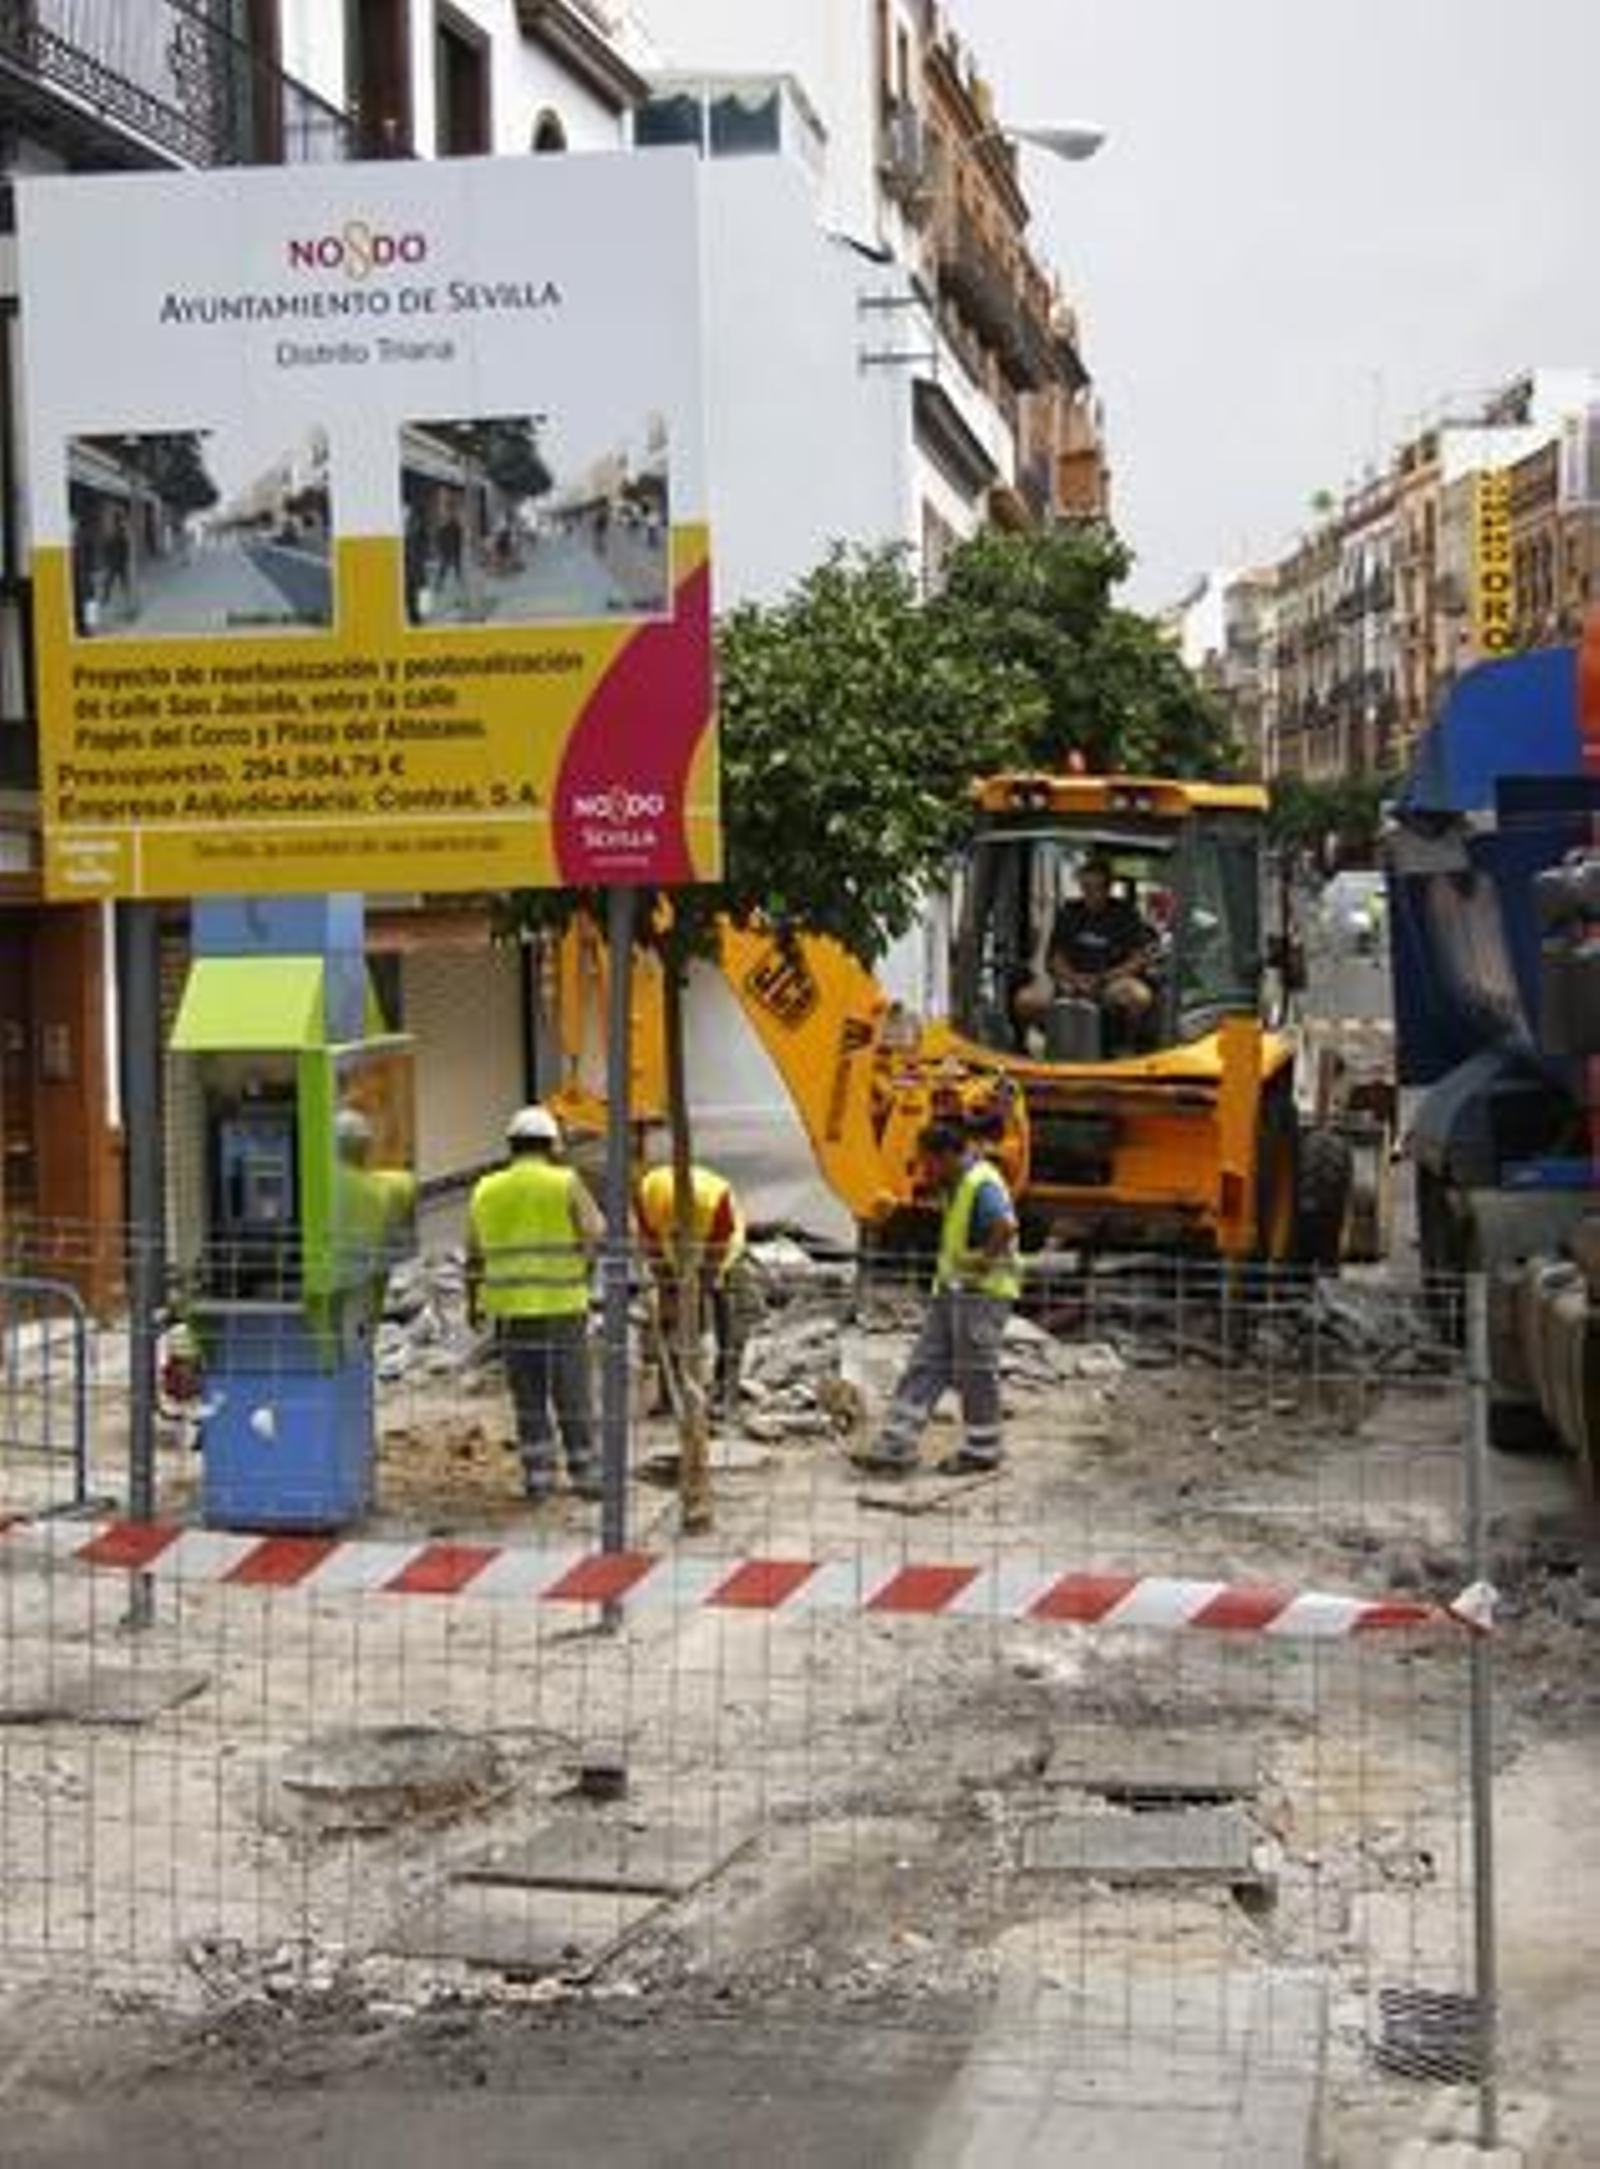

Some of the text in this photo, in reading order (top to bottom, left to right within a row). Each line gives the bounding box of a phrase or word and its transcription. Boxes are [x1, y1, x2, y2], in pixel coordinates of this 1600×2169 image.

[159, 279, 561, 325] AYUNTAMIENTO DE SEVILLA
[275, 337, 456, 370] Distrito Triana
[73, 665, 171, 690] Proyecto
[175, 663, 206, 685] de
[383, 659, 397, 682] y
[74, 697, 102, 720] de
[108, 694, 161, 719] calle
[166, 692, 213, 717] San
[305, 688, 369, 712] entre
[374, 686, 396, 709] la
[403, 683, 456, 709] calle
[150, 725, 184, 747] del
[190, 721, 252, 746] Corro
[256, 727, 269, 750] y
[275, 719, 337, 745] Plaza
[343, 716, 378, 741] del
[58, 794, 175, 822] Empresa
